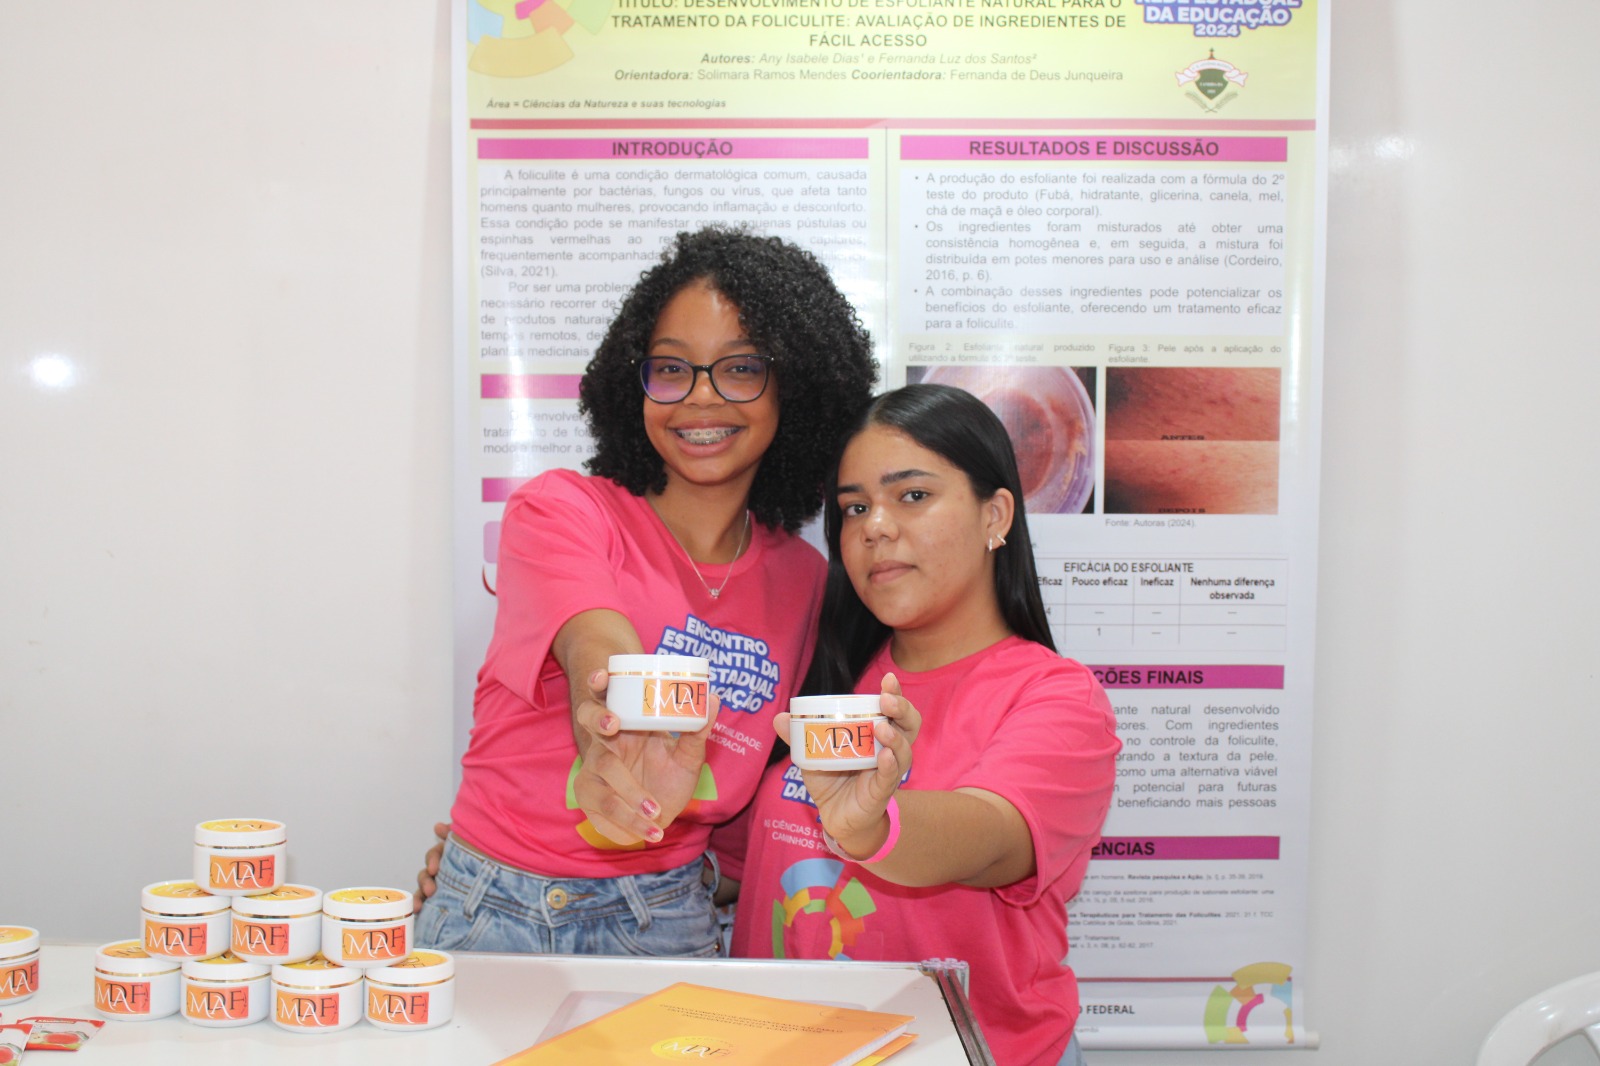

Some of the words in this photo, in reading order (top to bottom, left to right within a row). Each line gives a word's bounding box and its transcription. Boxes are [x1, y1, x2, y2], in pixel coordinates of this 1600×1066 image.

[611, 15, 720, 27] TRATAMENTO
[725, 15, 747, 27] DA
[752, 15, 849, 27] FOLICULITE:
[856, 15, 947, 30] AVALIAÇÃO
[954, 15, 973, 27] DE
[980, 15, 1099, 28] INGREDIENTES
[1105, 15, 1126, 27] DE
[1146, 7, 1173, 22] DA
[1178, 6, 1288, 27] EDUCAÇÃO
[1195, 24, 1238, 36] 2024
[810, 31, 855, 46] FÁCIL
[860, 34, 927, 47] ACESSO
[700, 53, 755, 64] Autores:
[758, 53, 782, 66] Any
[786, 53, 829, 64] Isabele
[879, 53, 936, 64] Fernanda
[940, 53, 961, 64] Luz
[965, 53, 986, 64] dos
[614, 69, 693, 81] Orientadora:
[697, 69, 750, 80] Solimara
[754, 69, 795, 80] Ramos
[800, 69, 847, 80] Mendes
[851, 69, 946, 80] Coorientadora:
[951, 69, 1007, 80] Fernanda
[1011, 70, 1026, 80] de
[1030, 69, 1061, 80] Deus
[1064, 70, 1123, 82] Junqueira
[522, 99, 565, 108] Ciências
[568, 99, 581, 108] da
[584, 100, 628, 108] Natureza
[668, 99, 726, 109] tecnologias
[612, 139, 733, 157] INTRODUÇÃO
[969, 141, 1090, 155] RESULTADOS
[1096, 141, 1107, 155] E
[1113, 139, 1219, 156] DISCUSSÃO
[504, 169, 514, 180] A
[518, 169, 566, 180] foliculite
[571, 169, 579, 180] é
[584, 171, 610, 180] uma
[616, 169, 669, 183] condição
[674, 169, 758, 182] dermatológica
[763, 171, 810, 181] comum,
[817, 170, 867, 180] causada
[926, 173, 935, 183] A
[940, 173, 995, 186] produção
[1000, 173, 1015, 184] do
[1020, 173, 1077, 184] esfoliante
[1082, 173, 1096, 184] foi
[1102, 173, 1155, 184] realizada
[1160, 176, 1185, 184] com
[1190, 176, 1198, 184] a
[1203, 174, 1247, 185] fórmula
[1252, 174, 1267, 185] do
[480, 185, 566, 198] principalmente
[573, 188, 593, 199] por
[599, 185, 656, 197] bactérias,
[663, 185, 704, 199] fungos
[710, 187, 725, 196] ou
[771, 187, 794, 198] que
[801, 185, 830, 196] afeta
[837, 186, 867, 196] tanto
[1133, 518, 1165, 527] Autoras
[1064, 561, 1111, 572] EFICÁCIA
[1114, 563, 1128, 572] DO
[1131, 563, 1194, 573] ESFOLIANTE
[1072, 577, 1100, 586] Pouco
[1102, 577, 1128, 586] eficaz
[1141, 577, 1174, 586] Ineficaz
[1191, 577, 1231, 586] Nenhuma
[1234, 577, 1275, 588] diferença
[1210, 591, 1254, 599] observada
[686, 616, 767, 656] ENCONTRO
[662, 629, 759, 672] ESTUDANTIL
[761, 659, 779, 682] DA
[708, 667, 774, 699] STADUAL
[1147, 670, 1204, 684] FINAIS
[1151, 704, 1191, 715] natural
[1203, 704, 1280, 715] desenvolvido
[1165, 719, 1192, 730] Com
[1208, 720, 1279, 733] ingredientes
[1127, 738, 1141, 746] no
[1149, 736, 1196, 746] controle
[1204, 736, 1219, 746] da
[1228, 735, 1278, 747] foliculite,
[1163, 753, 1170, 761] a
[1179, 752, 1218, 761] textura
[1227, 751, 1241, 761] da
[1249, 751, 1277, 763] pele.
[1180, 766, 1239, 776] alternativa
[1244, 766, 1278, 776] viável
[1133, 782, 1185, 794] potencial
[1198, 784, 1224, 794] para
[1237, 781, 1277, 792] futuras
[1118, 797, 1191, 808] beneficiando
[1196, 797, 1223, 807] mais
[1228, 799, 1277, 809] pessoas
[1087, 1005, 1135, 1014] FEDERAL
